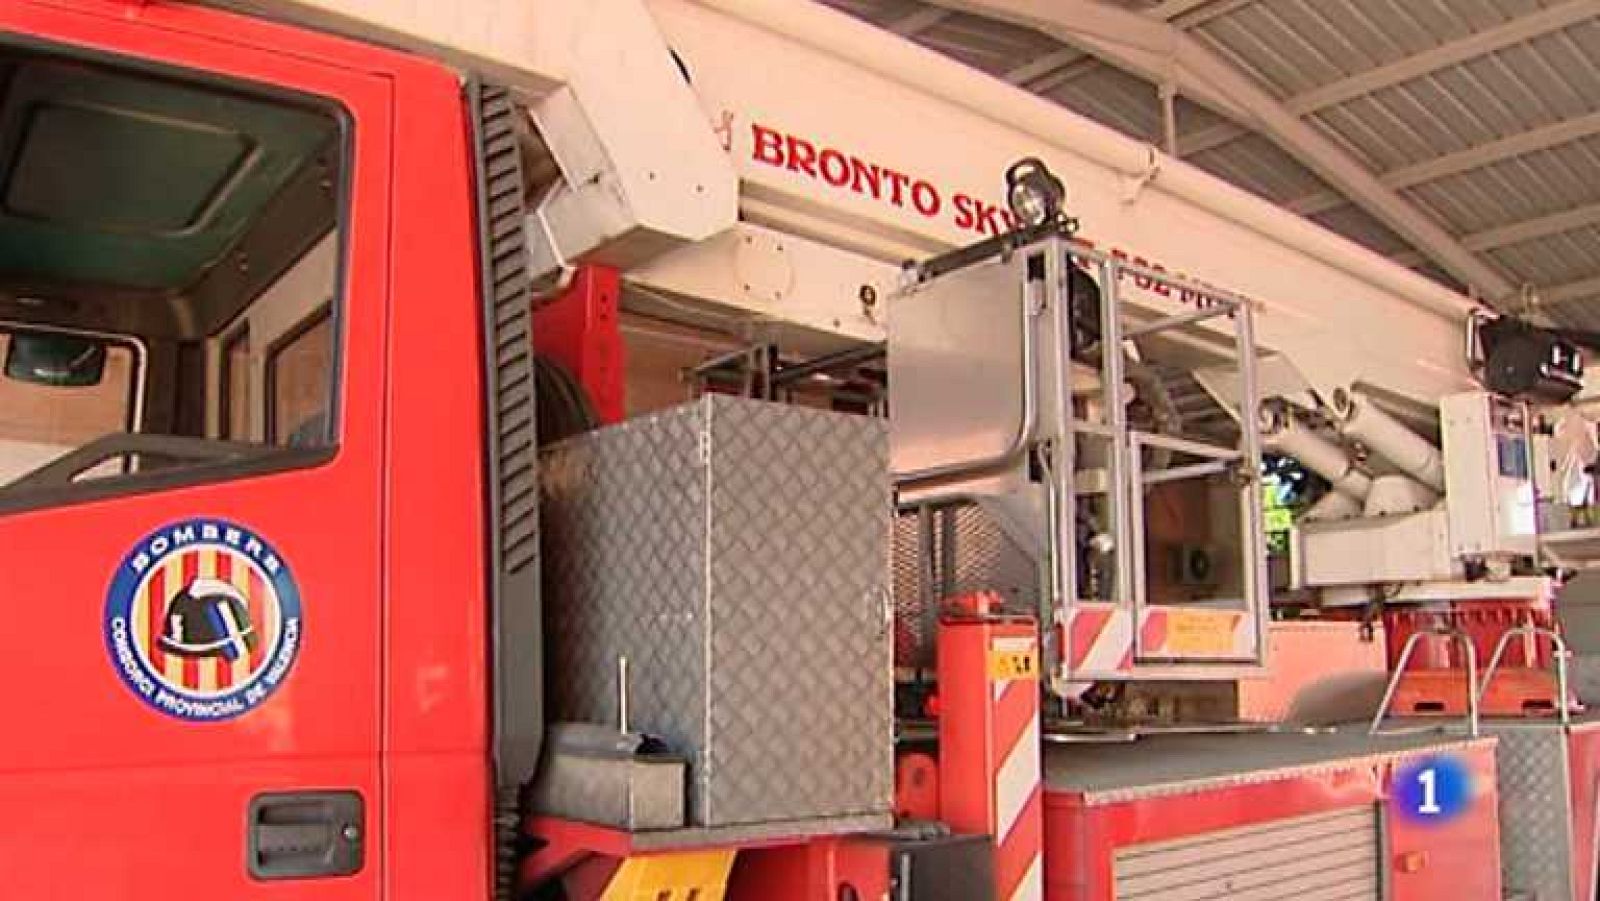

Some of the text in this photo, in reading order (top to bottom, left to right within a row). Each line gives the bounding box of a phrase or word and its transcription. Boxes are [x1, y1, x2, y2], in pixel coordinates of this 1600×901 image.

[751, 122, 941, 217] BRONTO
[132, 524, 280, 574] BOMBERS
[155, 689, 244, 717] PROVINCIAL
[246, 682, 266, 704] DE
[264, 617, 299, 686] VALENCIA
